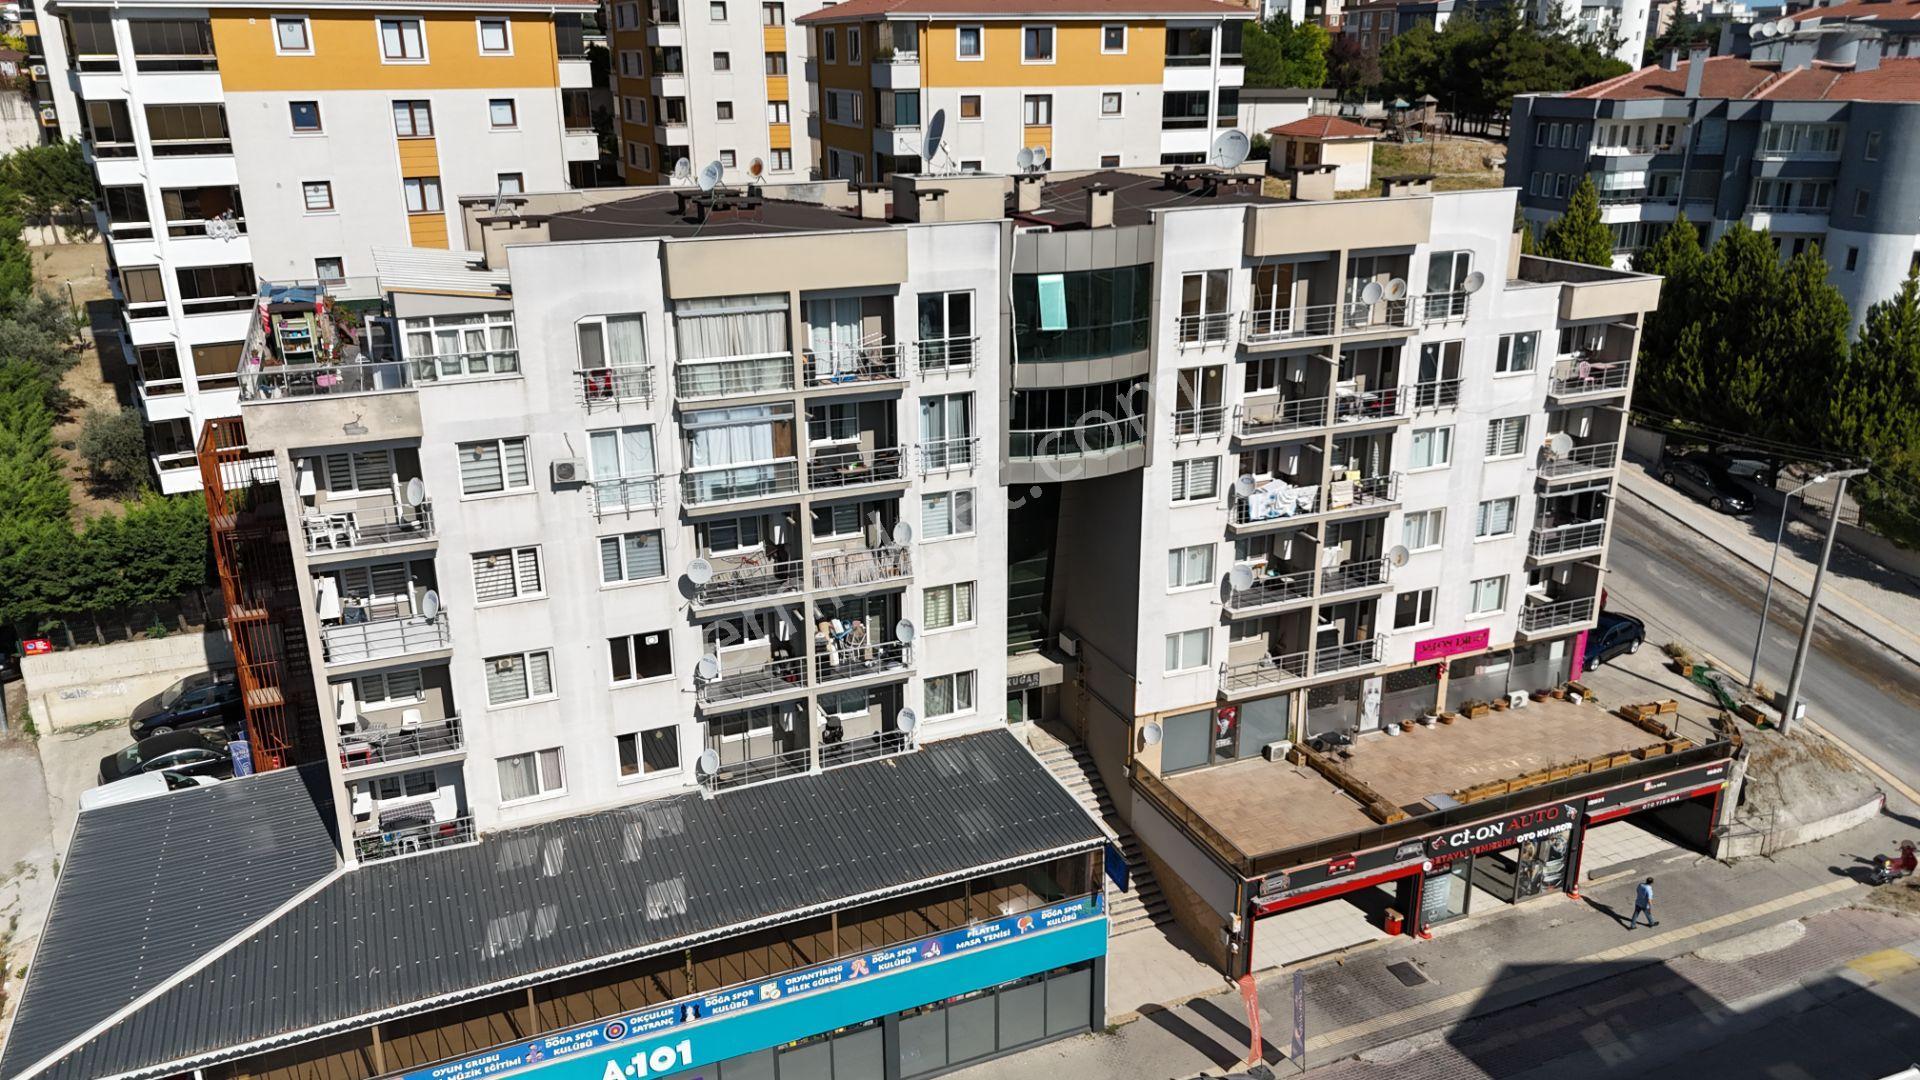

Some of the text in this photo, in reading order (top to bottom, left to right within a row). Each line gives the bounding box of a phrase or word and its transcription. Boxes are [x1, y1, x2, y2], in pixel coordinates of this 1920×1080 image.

[1506, 806, 1559, 832] AUTO
[1516, 832, 1536, 844] OTO
[1041, 909, 1063, 920] DOĞA
[1064, 904, 1083, 914] SPOR
[1046, 913, 1077, 927] KULÜBÜ
[956, 928, 1011, 950] MASA TENİSİ
[966, 924, 1000, 938] PİLATES
[872, 953, 896, 964] DOĞA
[897, 947, 918, 957] SPOR
[878, 955, 912, 971] KULÜBÜ
[787, 973, 842, 994] BİLEK GÜREŞİ
[705, 989, 755, 1008] DOĞA SPOR
[712, 999, 749, 1015] KULÜBÜ
[629, 1008, 674, 1025] OKÇULUK
[631, 1017, 674, 1034] SATRANÇ
[545, 1034, 573, 1049] DOĞA
[575, 1029, 600, 1041] SPOR
[553, 1039, 593, 1056] KULÜBÜ
[432, 1054, 500, 1078] OYUN GRUBU
[447, 1057, 522, 1080] MÜZİK EĞİTİMİ
